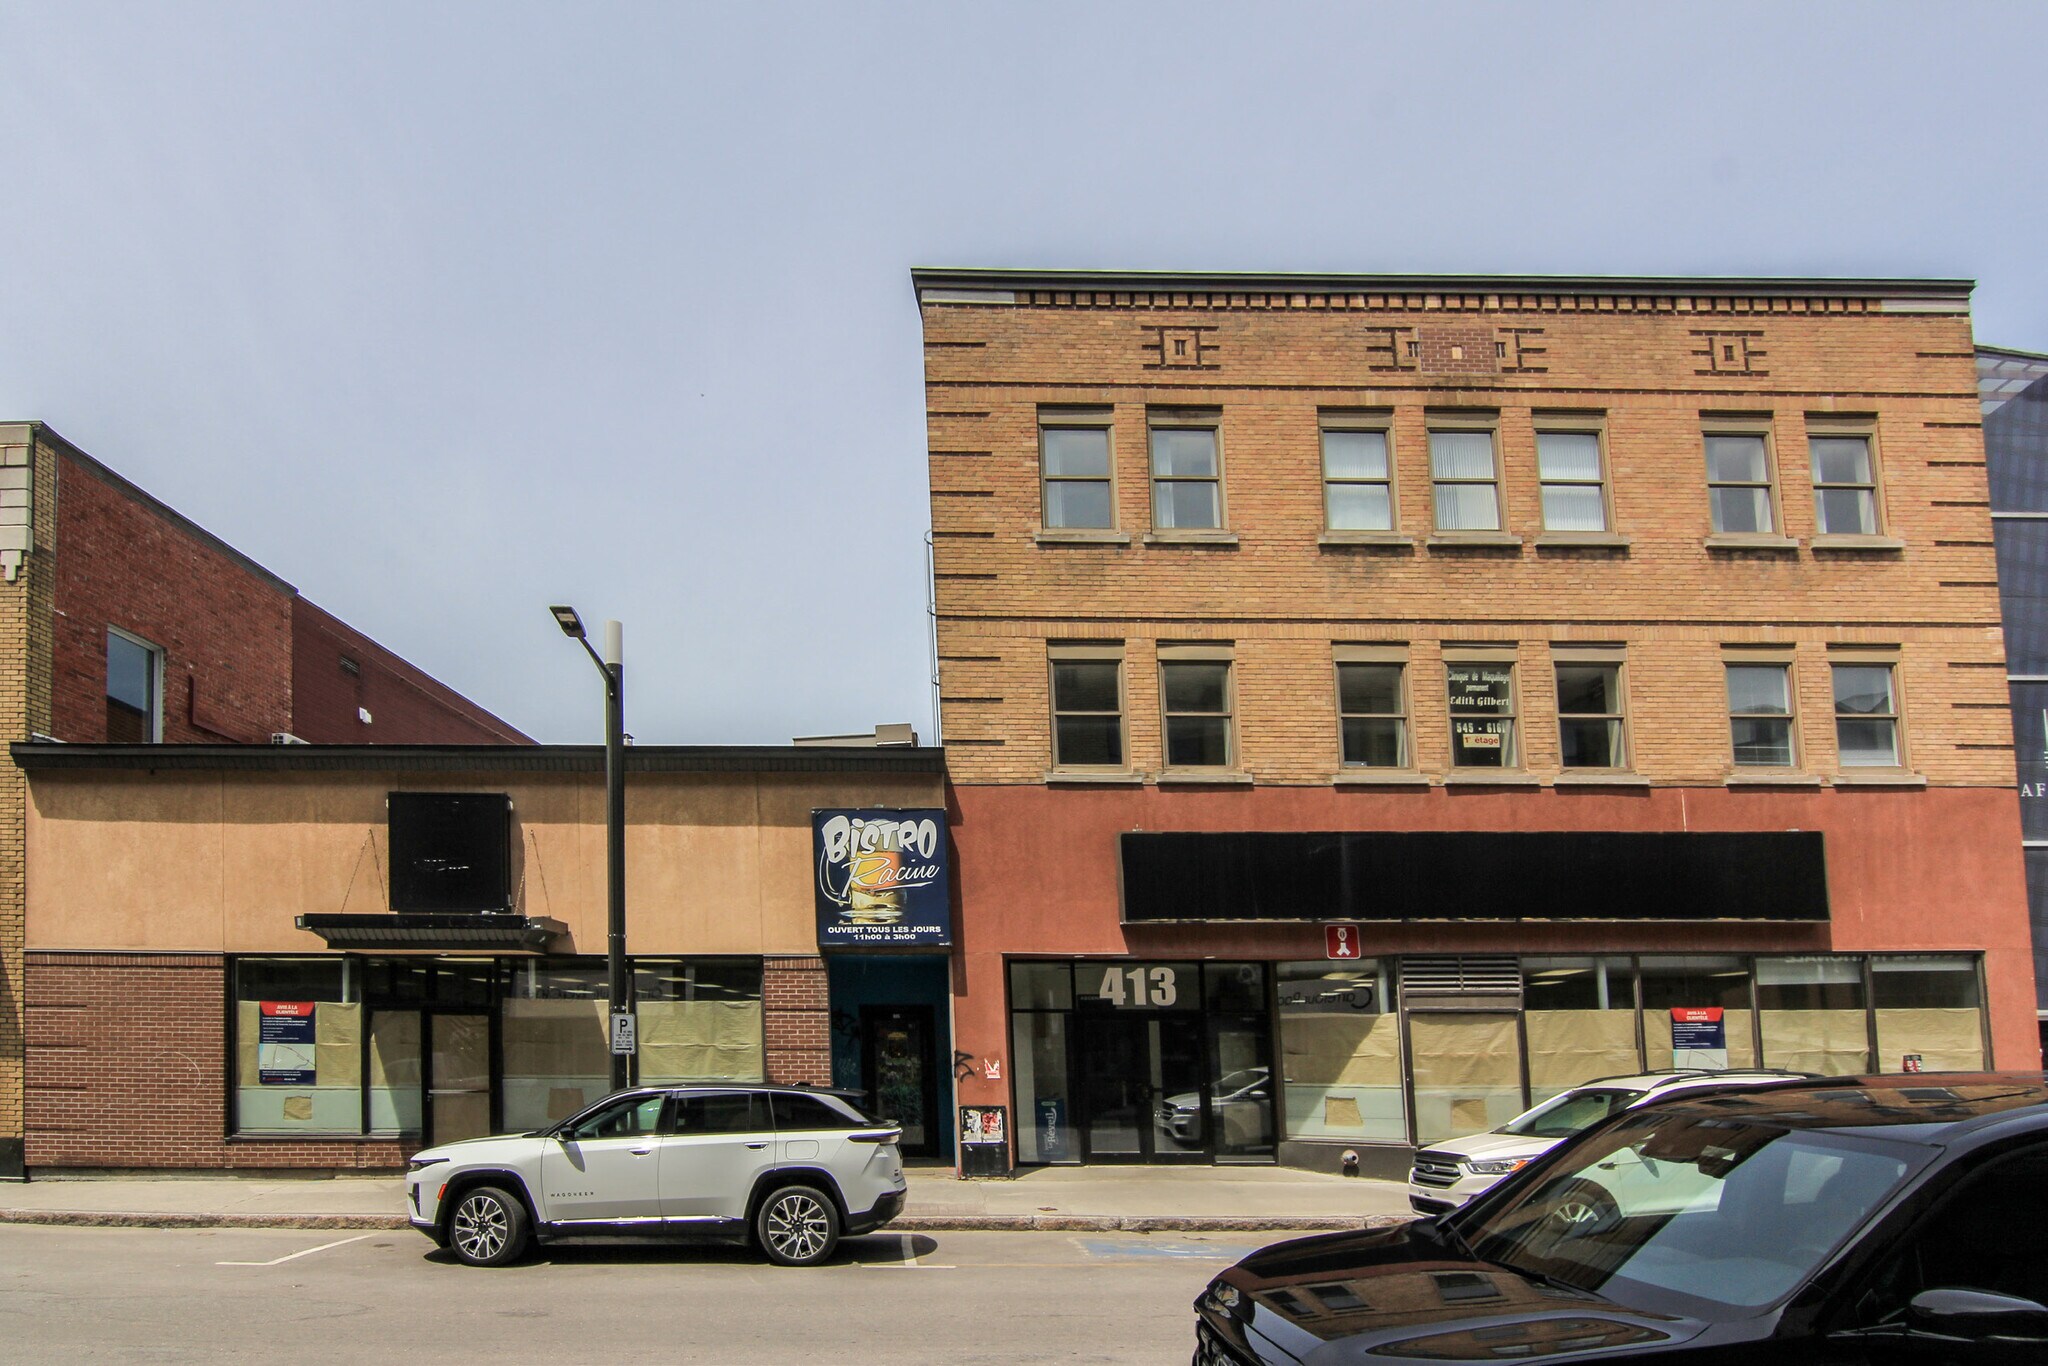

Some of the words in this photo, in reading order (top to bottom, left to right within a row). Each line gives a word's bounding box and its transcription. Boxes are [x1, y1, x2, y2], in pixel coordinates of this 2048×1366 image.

[1471, 671, 1479, 681] de
[1450, 696, 1475, 706] Edith
[1477, 696, 1509, 707] Gilbert
[1456, 722, 1474, 733] 545
[1475, 736, 1499, 745] étage
[841, 857, 940, 898] Racine
[827, 926, 864, 934] OUVERT
[1099, 967, 1177, 1006] 413
[620, 1018, 628, 1033] P
[1045, 1112, 1056, 1142] Réveil
